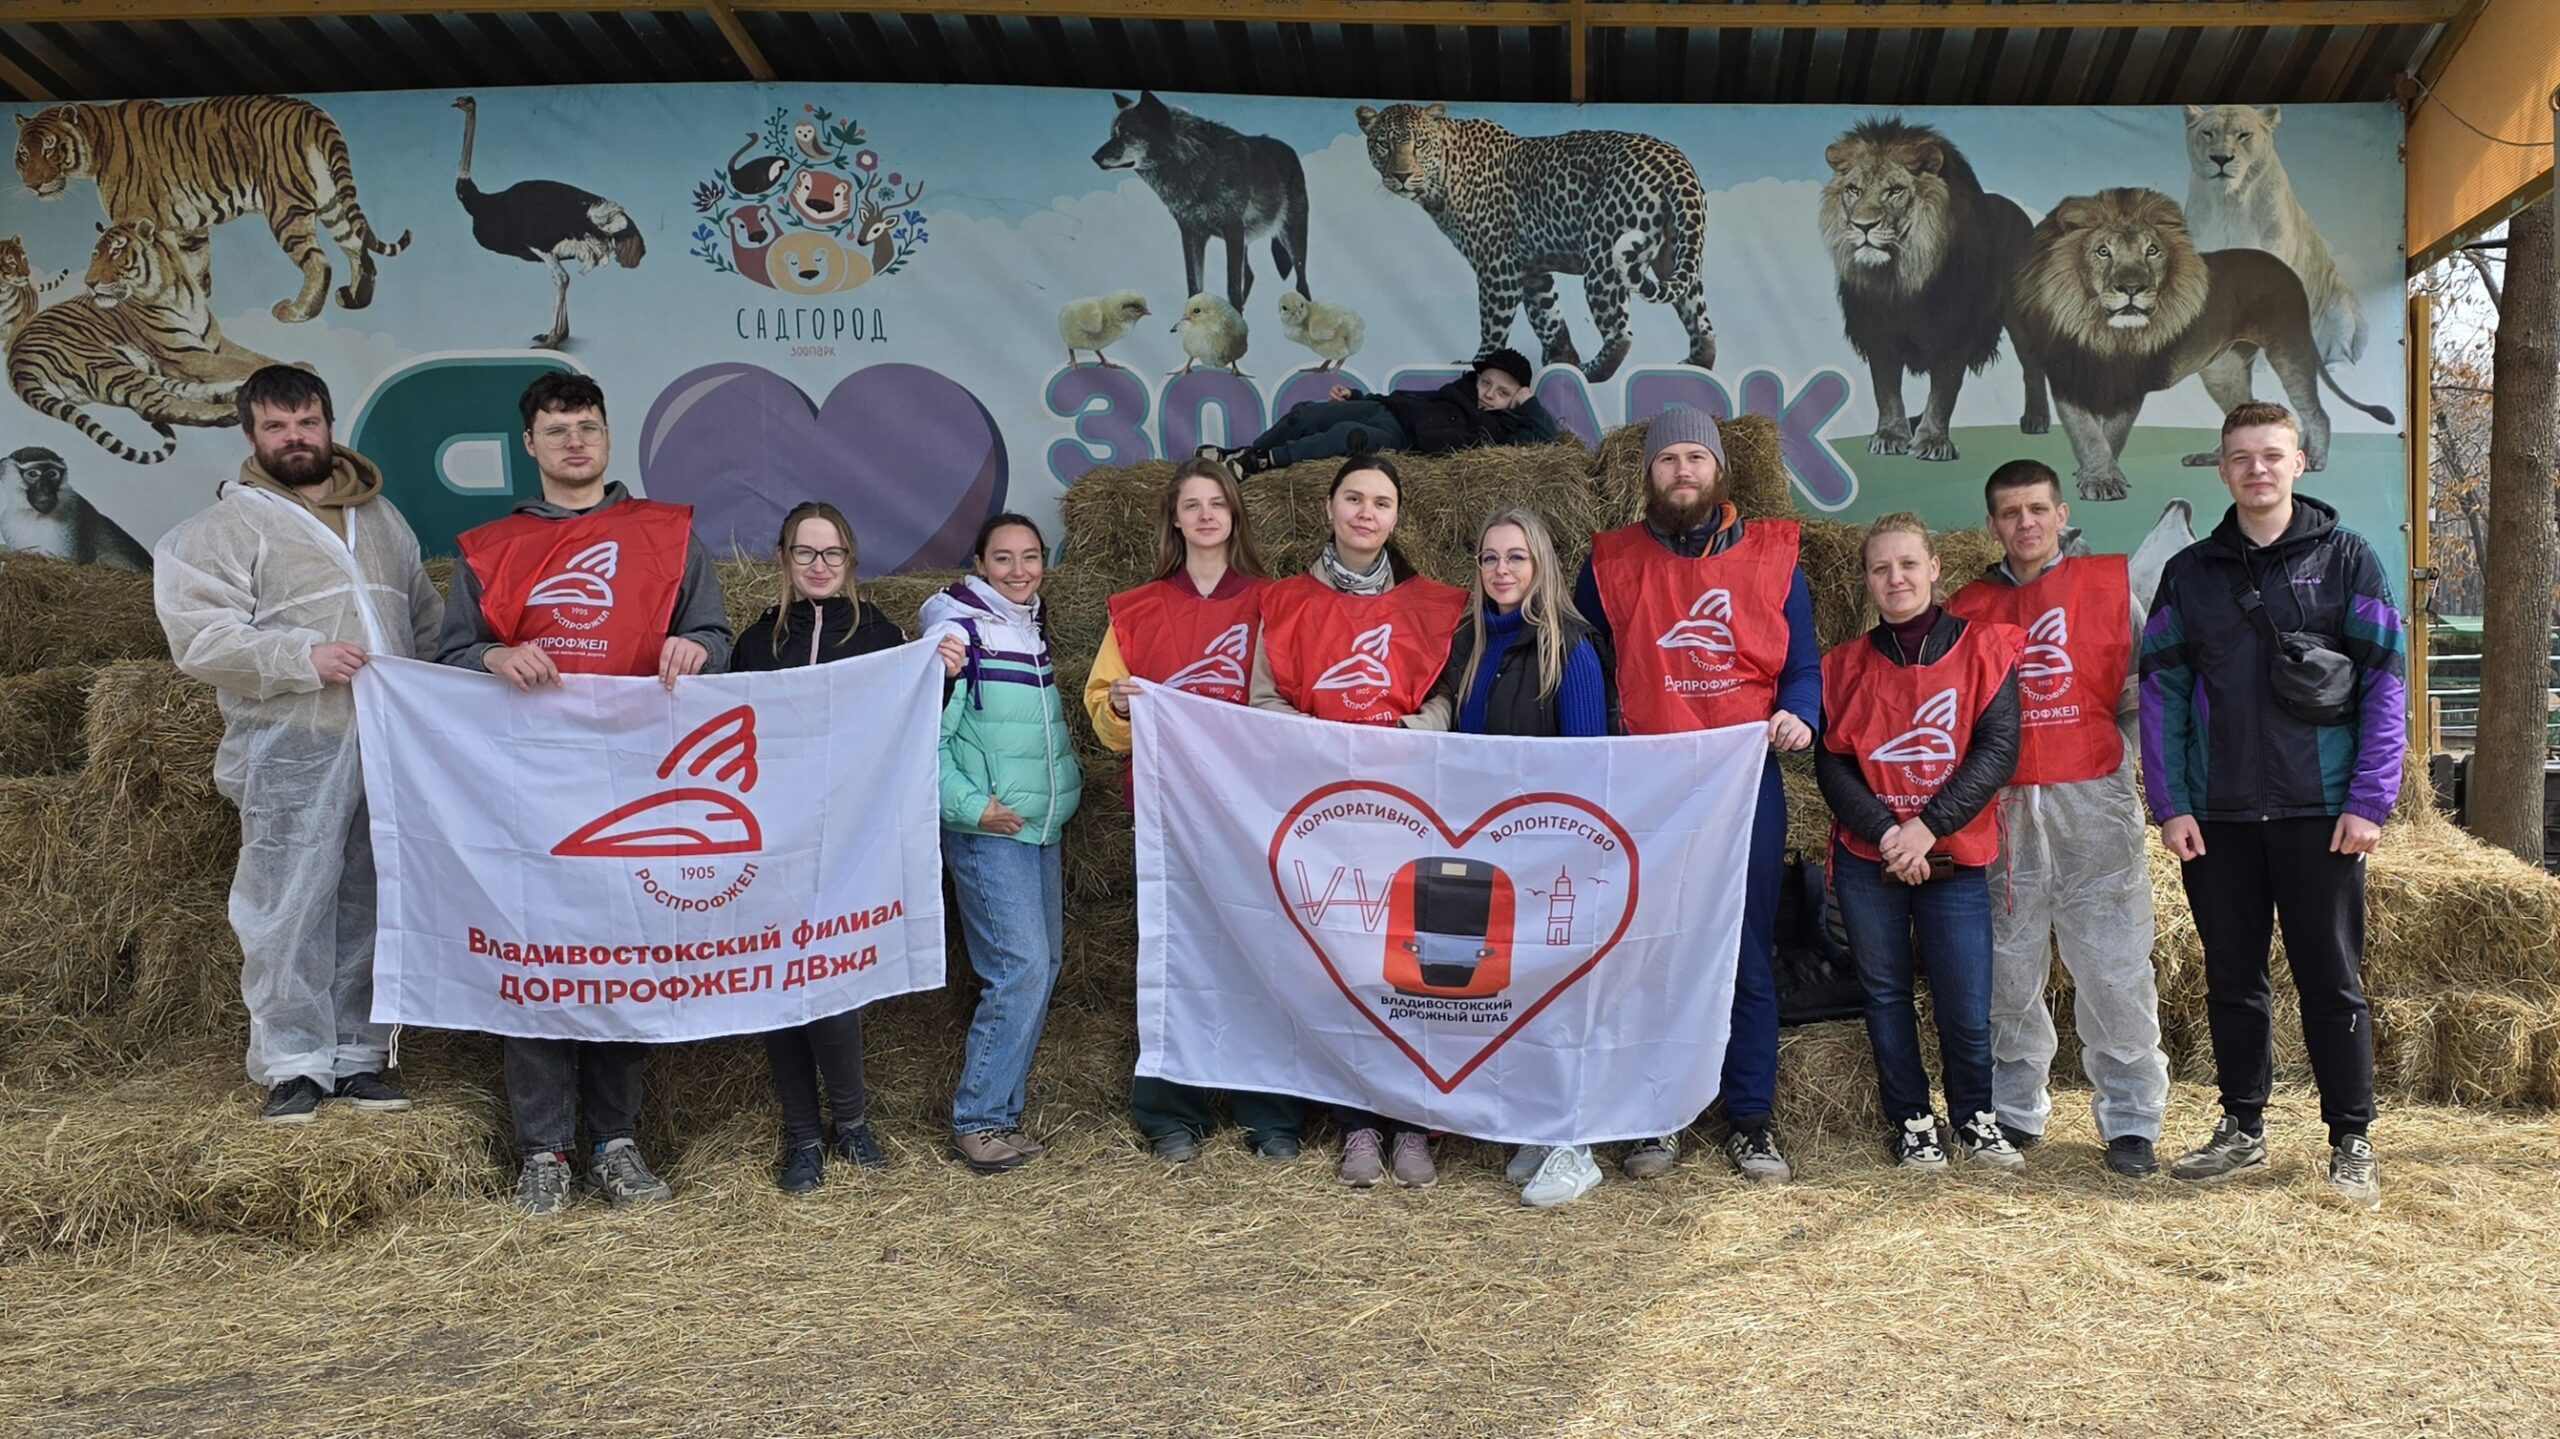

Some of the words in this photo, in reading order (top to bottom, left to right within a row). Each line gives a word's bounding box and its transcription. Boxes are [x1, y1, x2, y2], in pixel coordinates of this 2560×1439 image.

[736, 307, 888, 342] САДГОРОД
[552, 607, 610, 630] РОСПРОФЖЕЛ
[1293, 802, 1431, 840] КОРПОРАТИВНОЕ
[1490, 815, 1616, 854] ВОЛОНТЕРСТВО
[634, 861, 760, 913] РОСПРОФЖЕЛ
[680, 865, 716, 881] 1905
[467, 923, 782, 967] Владивостокский
[791, 899, 905, 949] филиал
[499, 961, 774, 1006] ДОРПРОФЖЕЛ
[781, 944, 878, 991] ДВжд
[1380, 995, 1513, 1012] ВЛАДИВОСТОКСКИЙ
[1388, 1007, 1468, 1022] ДОРОЖНЫЙ
[1471, 1011, 1509, 1024] ШТАБ
